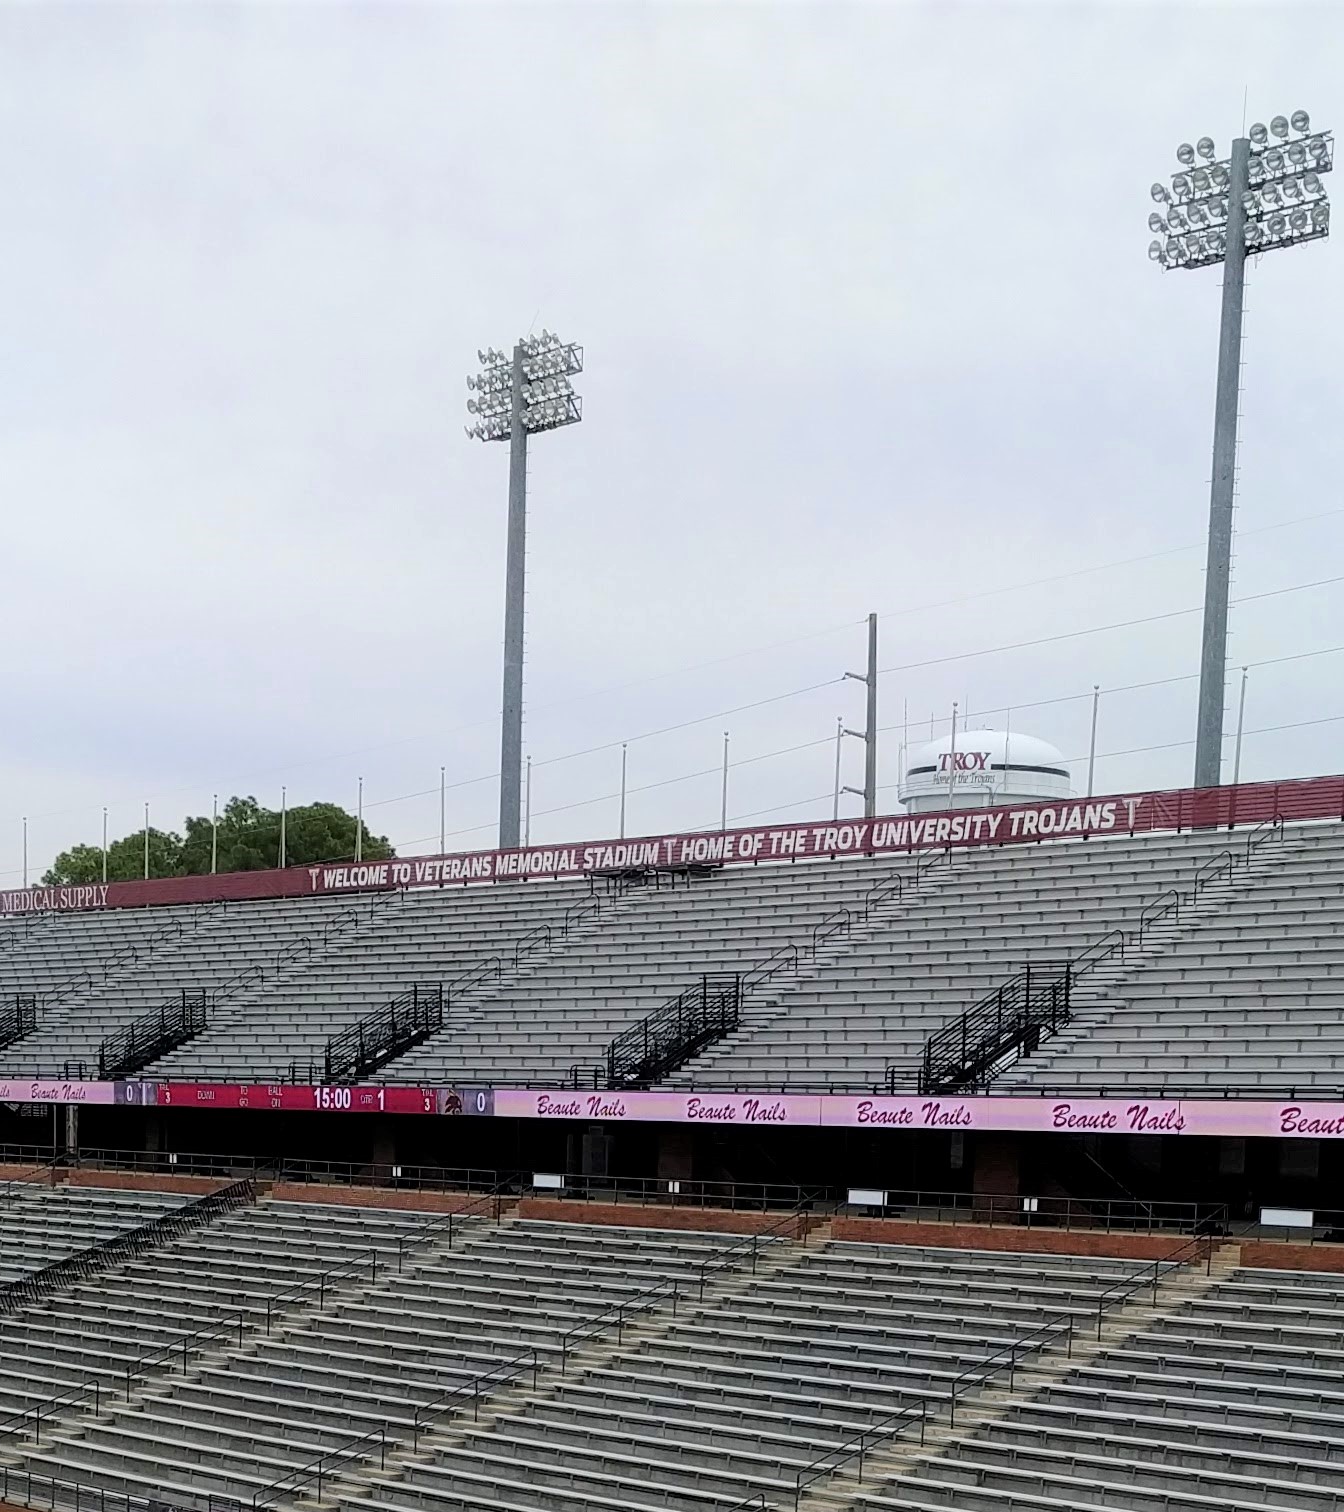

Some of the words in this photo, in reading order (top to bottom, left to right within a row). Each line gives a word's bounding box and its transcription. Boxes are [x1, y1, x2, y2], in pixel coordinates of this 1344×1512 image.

[938, 752, 991, 771] TROY
[323, 865, 388, 888] WELCOME
[391, 863, 411, 883] TO
[414, 856, 492, 882] VETERANS
[496, 849, 580, 876] MEMORIAL
[583, 842, 659, 869] STADIUM
[681, 835, 734, 862] HOME
[738, 832, 765, 857] OF
[769, 828, 809, 855] THE
[813, 823, 868, 851] TROY
[872, 812, 1004, 849] UNIVERSITY
[1008, 802, 1118, 836] TROJANS
[2, 888, 56, 913] MEDICAL
[58, 885, 109, 908] SUPPLY
[61, 1083, 86, 1100] Nails
[126, 1084, 133, 1101] 0
[165, 1091, 171, 1104] 3
[313, 1087, 351, 1109] 15:00
[377, 1089, 385, 1111] 1
[477, 1092, 486, 1112] 0
[424, 1097, 431, 1112] 3
[536, 1094, 581, 1116] Beaute
[585, 1095, 627, 1118] Nails
[686, 1097, 736, 1120] Beaute
[742, 1098, 787, 1122] Nails
[856, 1101, 916, 1124] Beaute
[921, 1102, 972, 1127] Nails
[1051, 1103, 1118, 1131] Beaute
[1126, 1104, 1187, 1132] Nails
